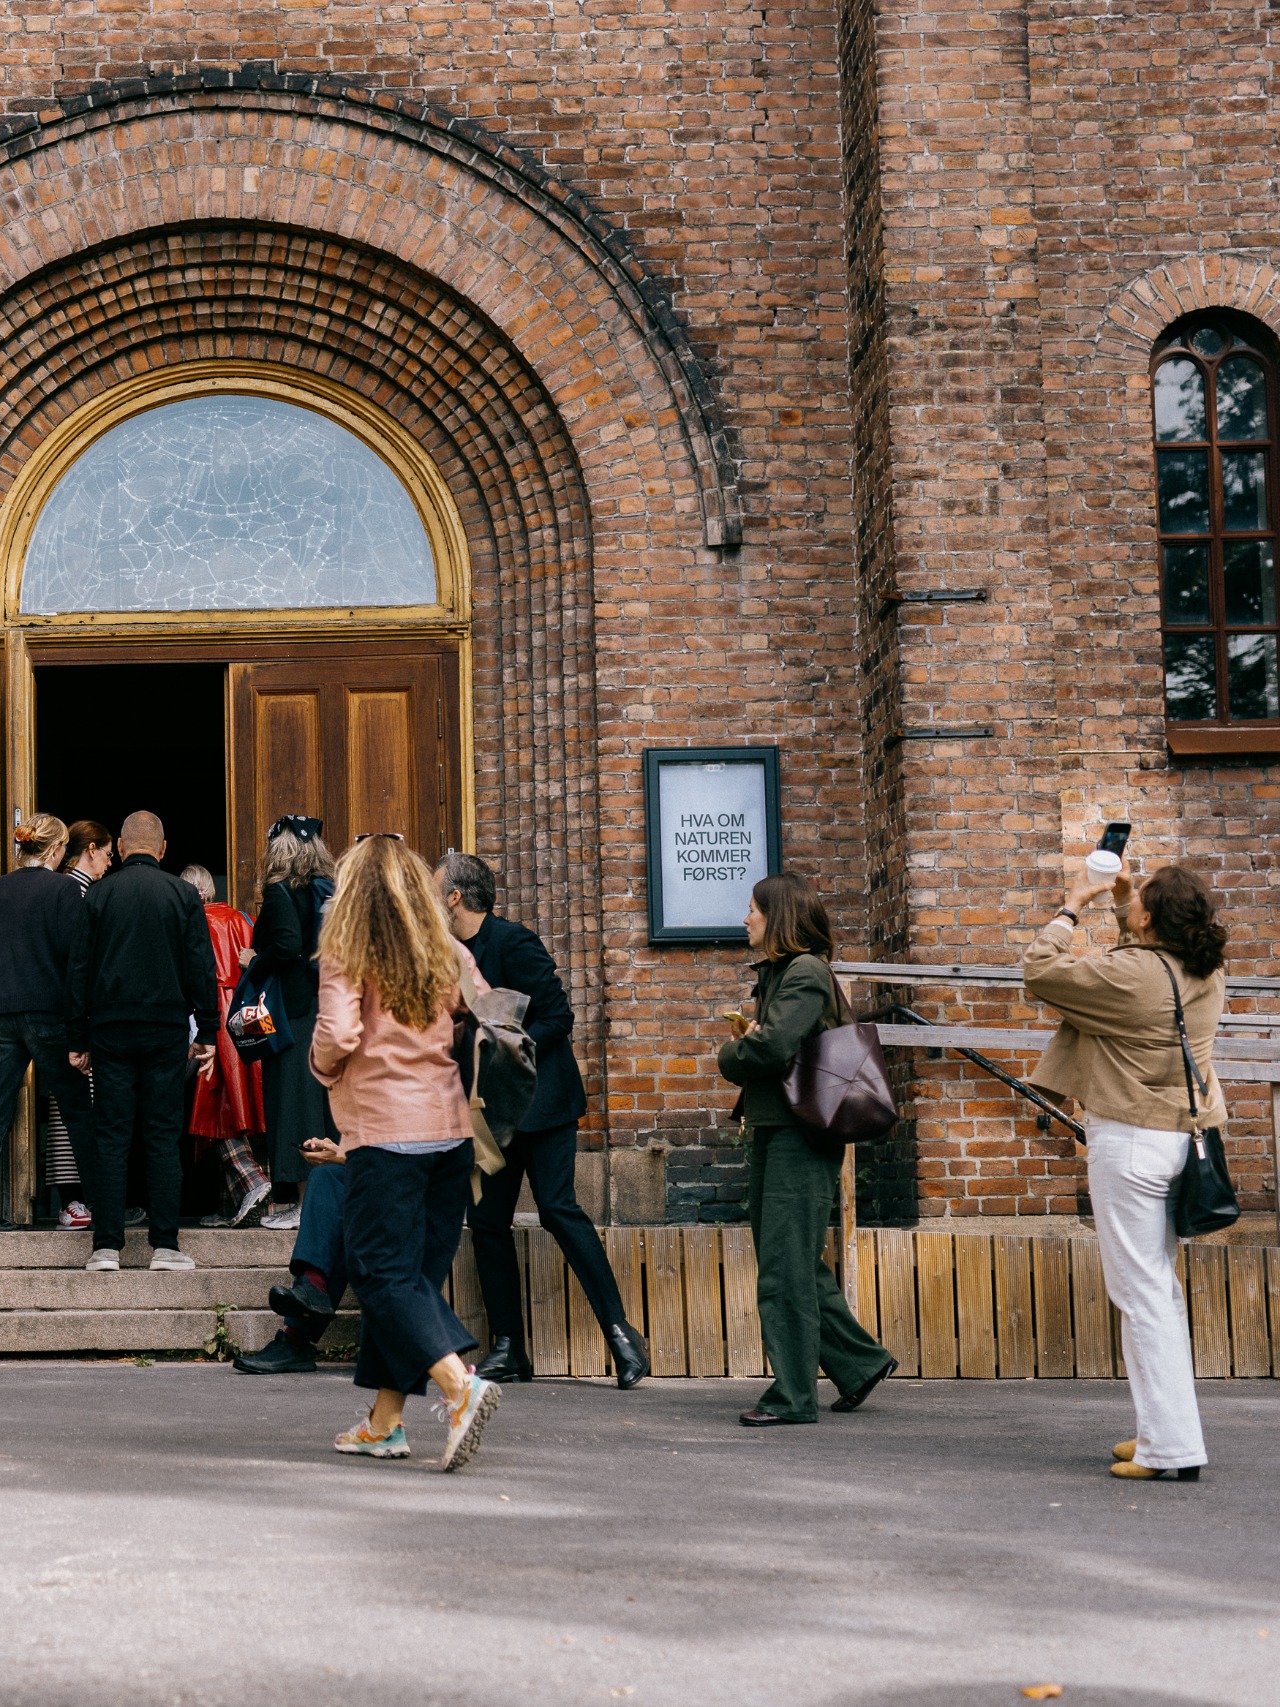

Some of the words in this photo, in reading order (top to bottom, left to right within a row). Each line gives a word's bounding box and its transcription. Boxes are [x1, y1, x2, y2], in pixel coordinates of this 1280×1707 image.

[681, 813, 714, 828] HVA
[717, 813, 745, 827] OM
[674, 831, 752, 846] NATUREN
[677, 849, 752, 863] KOMMER
[683, 866, 747, 881] FØRST?
